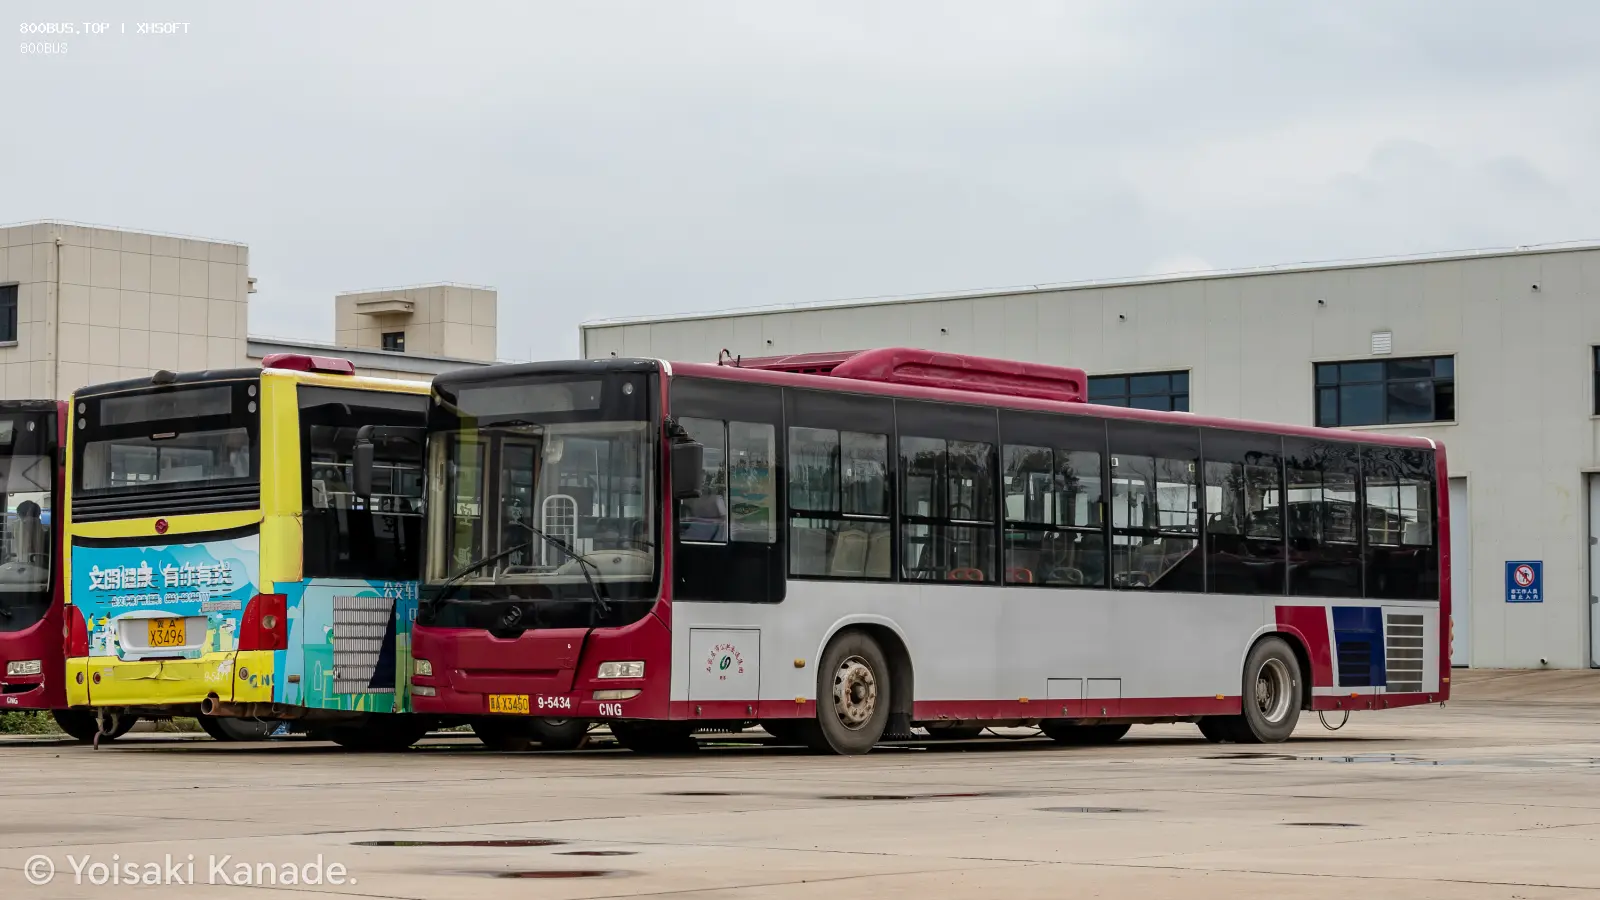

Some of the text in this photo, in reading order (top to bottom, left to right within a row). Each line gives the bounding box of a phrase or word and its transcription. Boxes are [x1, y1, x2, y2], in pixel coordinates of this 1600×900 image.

[88, 560, 234, 591] 文明健康 有你有我
[150, 629, 184, 646] X3496
[537, 696, 571, 709] 9-5434
[599, 703, 623, 716] CNG
